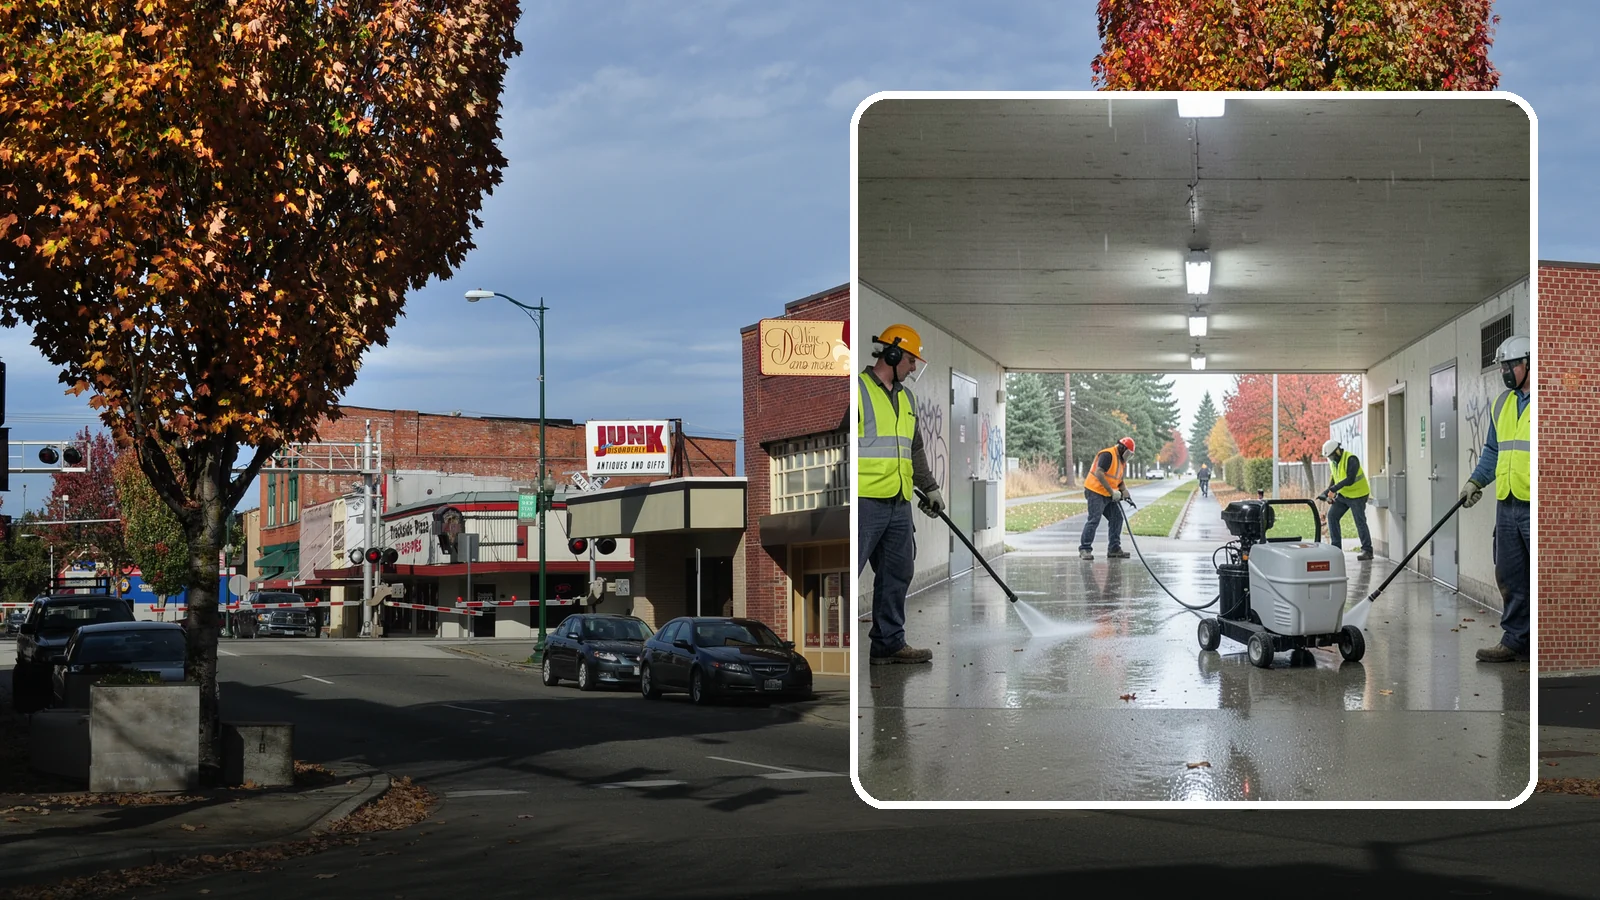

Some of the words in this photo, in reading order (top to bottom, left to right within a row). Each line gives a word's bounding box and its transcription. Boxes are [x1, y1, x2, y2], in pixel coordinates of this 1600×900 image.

[765, 327, 831, 366] Decor
[596, 425, 664, 457] JUNK
[607, 446, 646, 454] DISORDERLY
[597, 461, 628, 470] ANTIQUES
[631, 461, 643, 470] AND
[647, 460, 665, 469] GIFTS
[573, 473, 589, 490] RAIL
[390, 520, 413, 540] Trackside
[414, 519, 429, 535] Pizza
